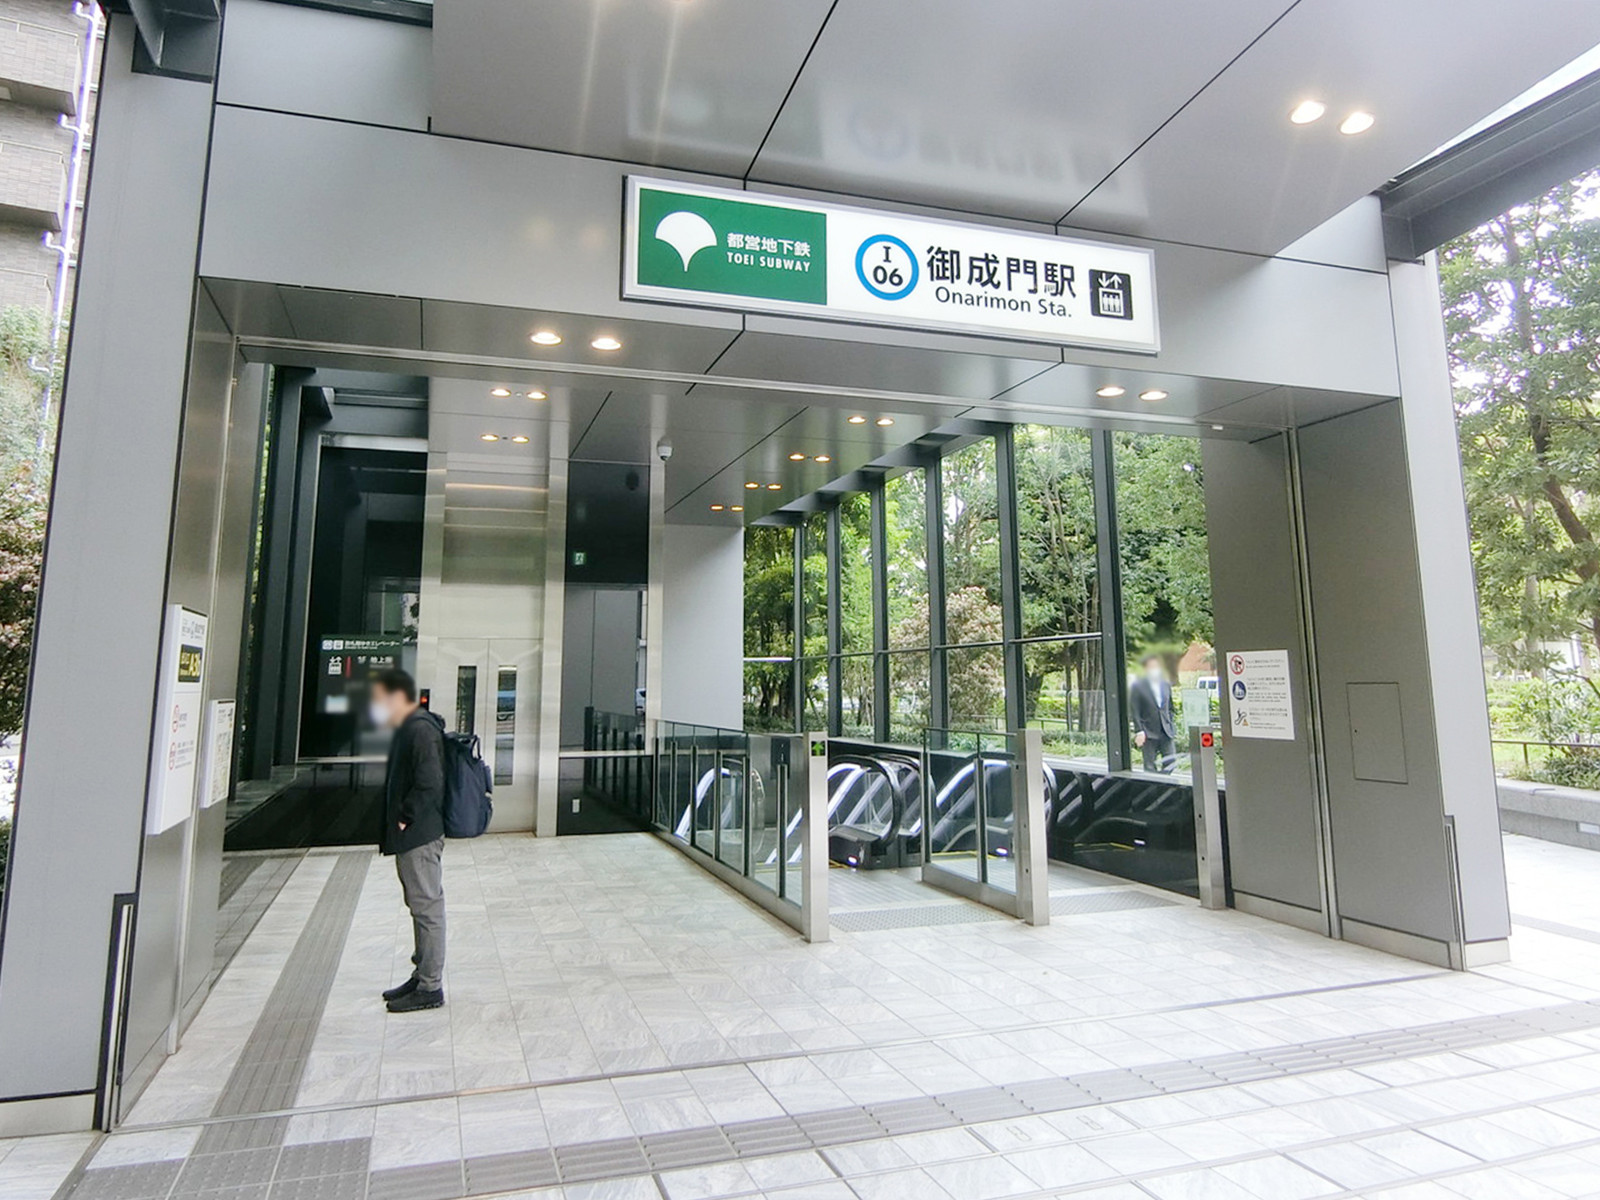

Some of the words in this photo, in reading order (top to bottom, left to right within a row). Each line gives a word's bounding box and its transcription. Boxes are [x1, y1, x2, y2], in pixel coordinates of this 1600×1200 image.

[727, 233, 811, 257] 都営地下鉄
[883, 246, 892, 263] I
[727, 252, 754, 266] TOEI
[760, 256, 810, 272] SUBWAY
[926, 245, 1076, 298] 御成門駅
[872, 265, 903, 287] 06
[935, 286, 1031, 312] Onarimon
[1038, 298, 1072, 318] Sta.
